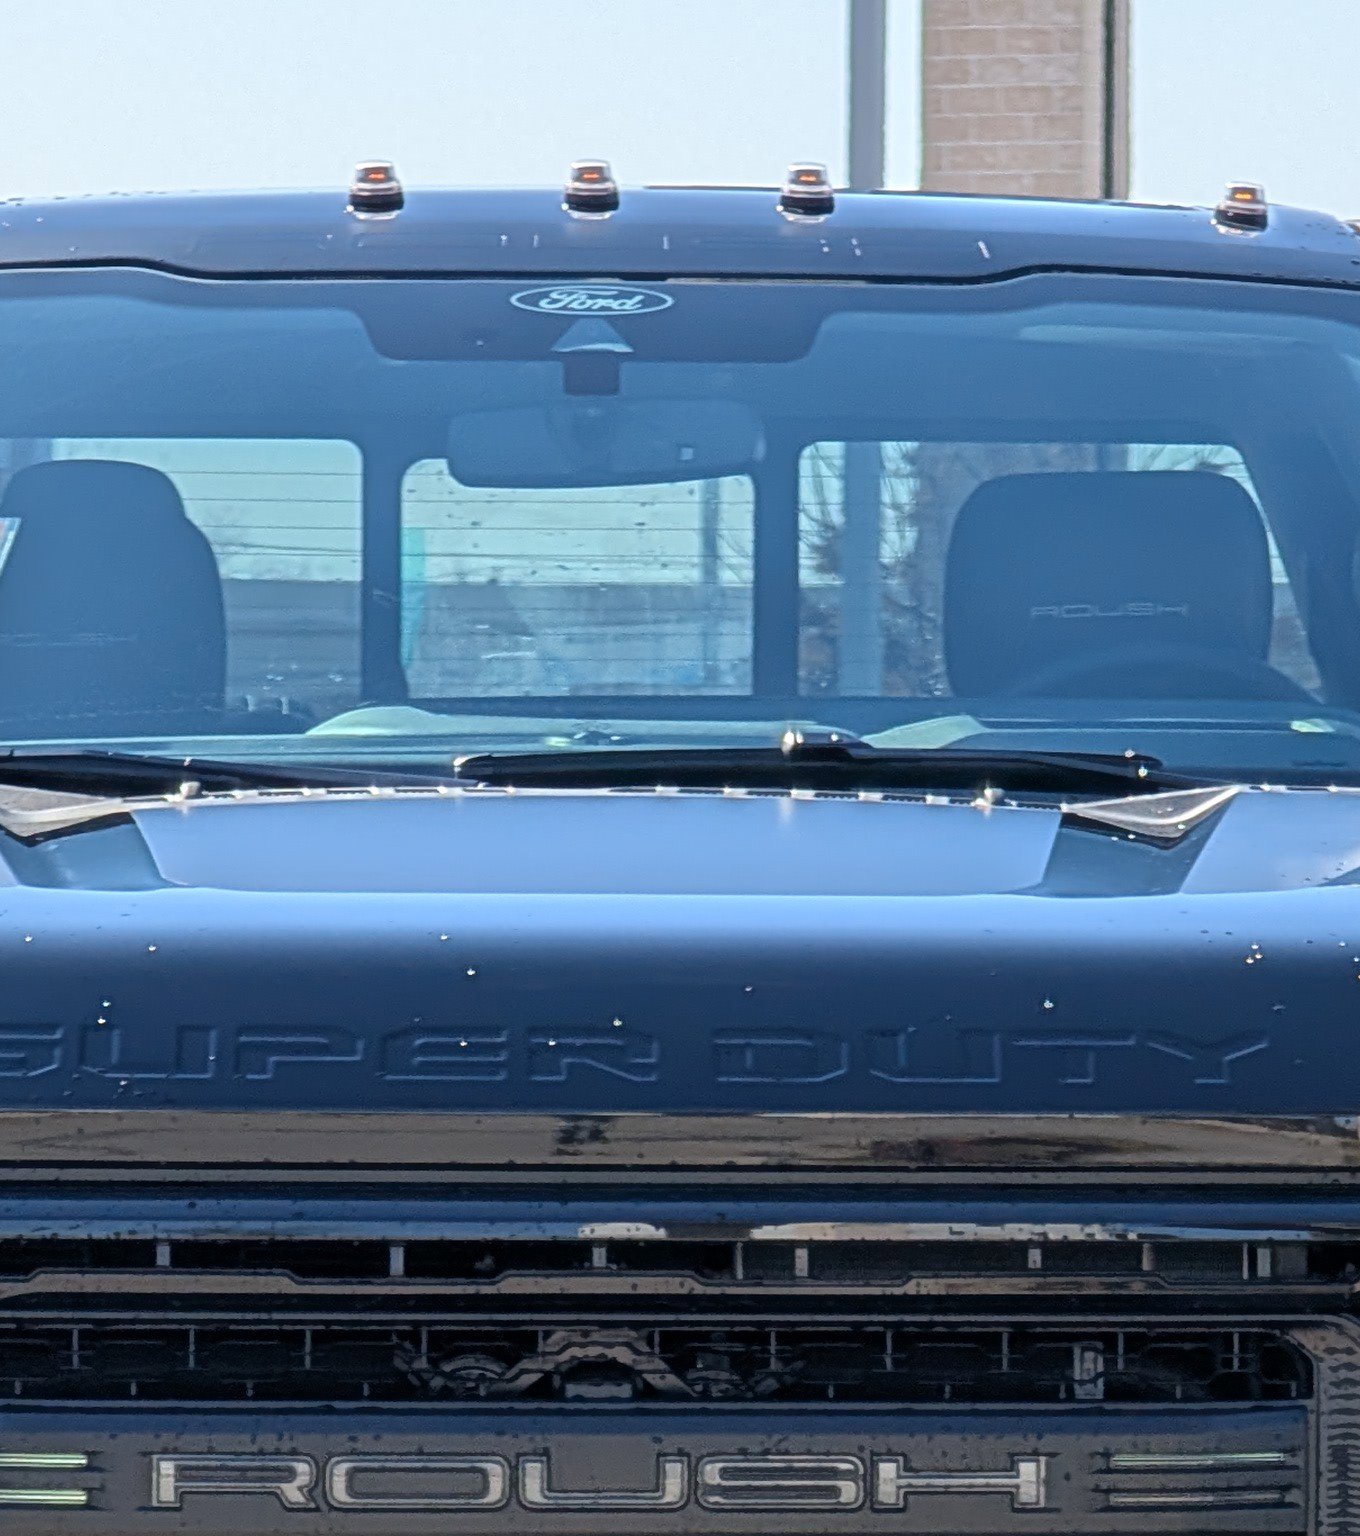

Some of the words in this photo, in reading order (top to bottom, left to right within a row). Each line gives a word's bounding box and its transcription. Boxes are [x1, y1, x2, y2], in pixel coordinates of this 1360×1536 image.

[538, 289, 645, 311] Ford
[714, 1026, 1270, 1085] DUTY
[151, 1453, 1047, 1512] ROUSH
